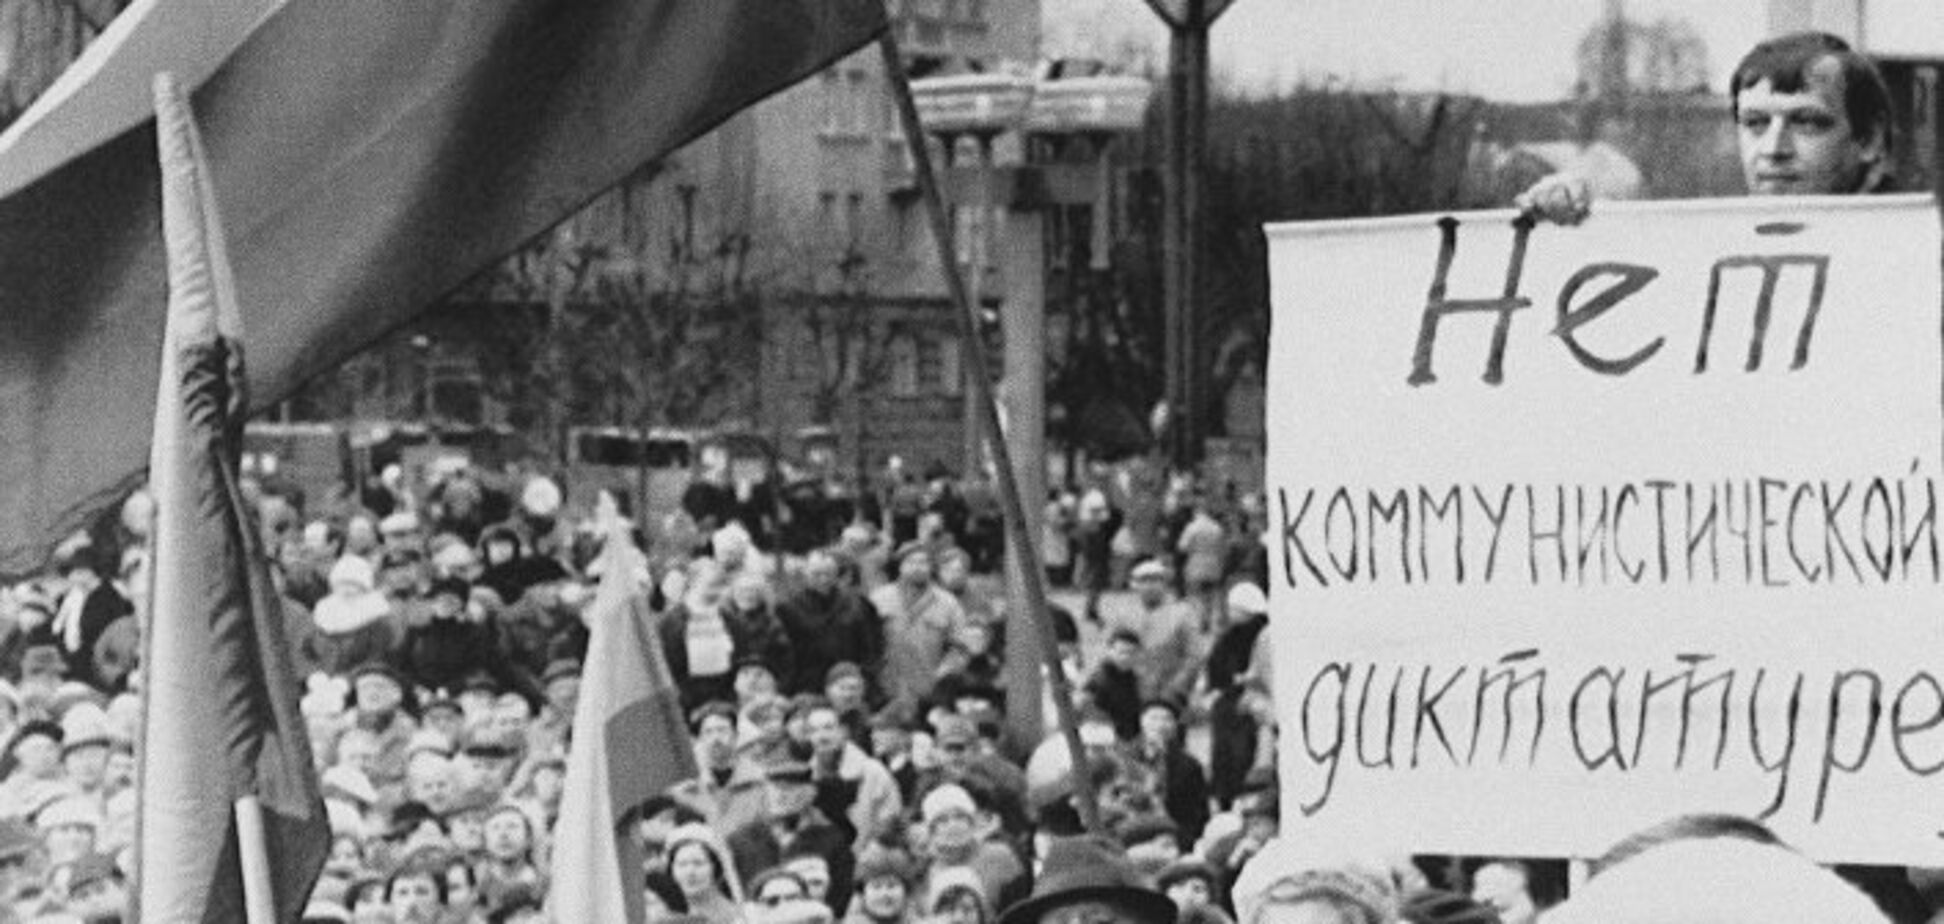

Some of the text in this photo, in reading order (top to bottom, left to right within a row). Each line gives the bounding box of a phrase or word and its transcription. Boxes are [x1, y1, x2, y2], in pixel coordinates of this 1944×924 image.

[1407, 216, 1830, 387] Нет
[1278, 458, 1940, 588] КОММУНИСТИЧЕСКОЙ
[1301, 648, 1944, 824] диктатуре
